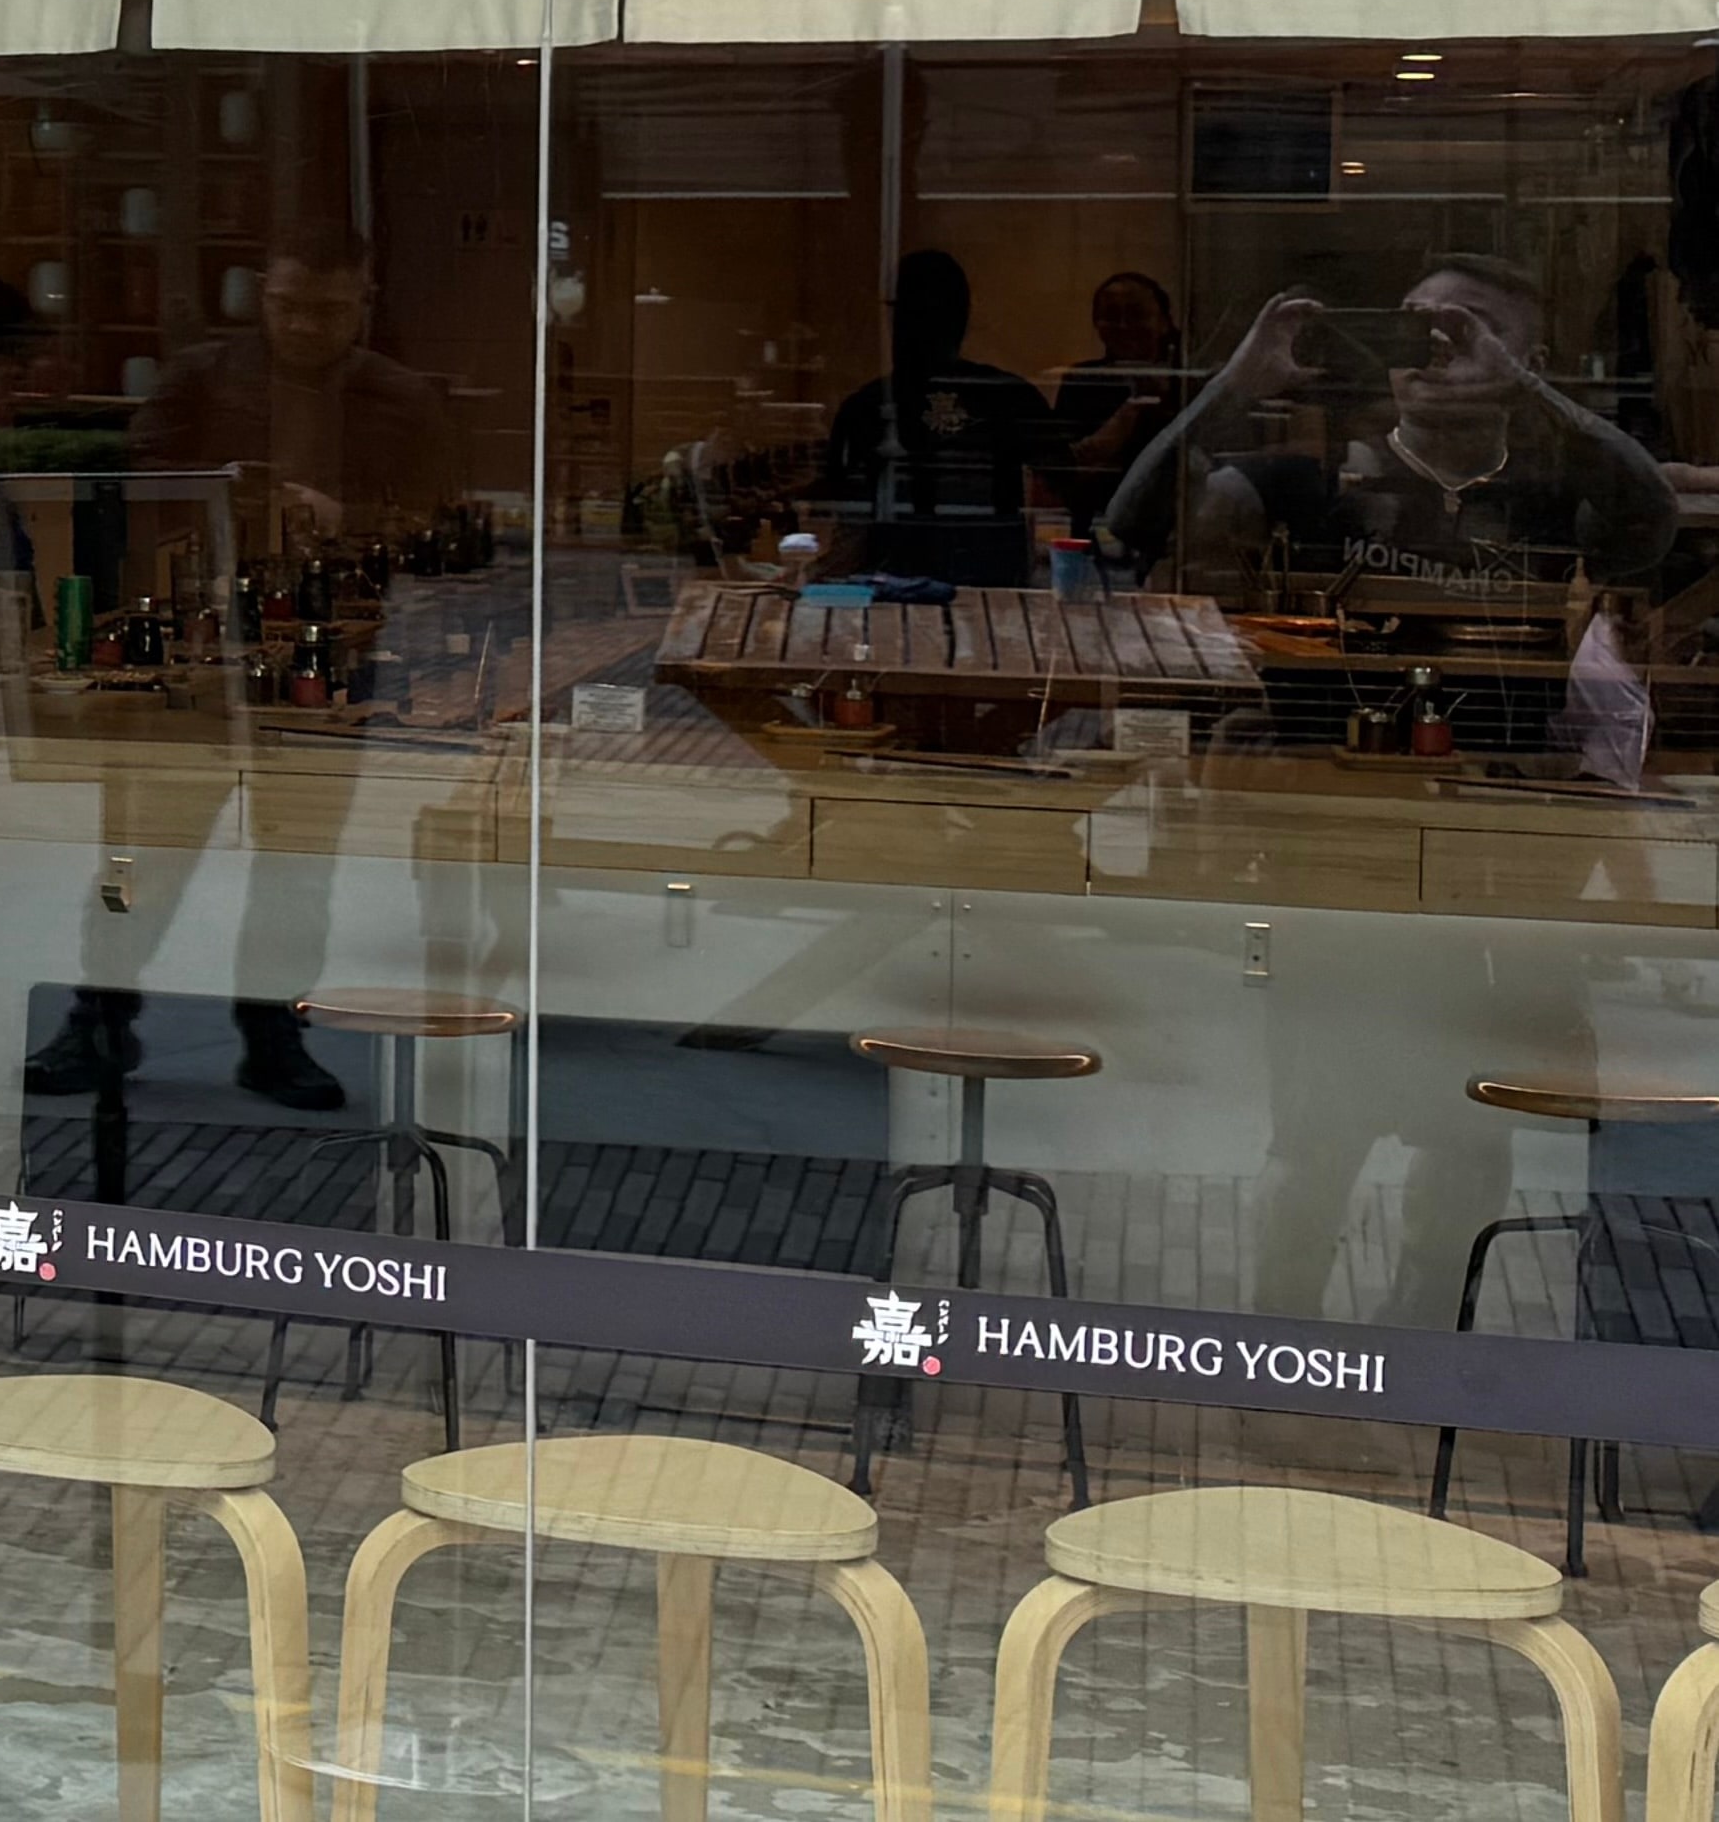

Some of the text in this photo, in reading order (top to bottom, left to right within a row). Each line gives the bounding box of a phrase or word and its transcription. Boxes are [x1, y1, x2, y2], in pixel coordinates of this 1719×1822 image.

[86, 1225, 304, 1286] HAMBURG
[314, 1251, 448, 1302] YOSHI
[852, 1289, 933, 1366] 嘉
[977, 1316, 1223, 1376] HAMBURG
[1235, 1338, 1386, 1393] YOSHI
